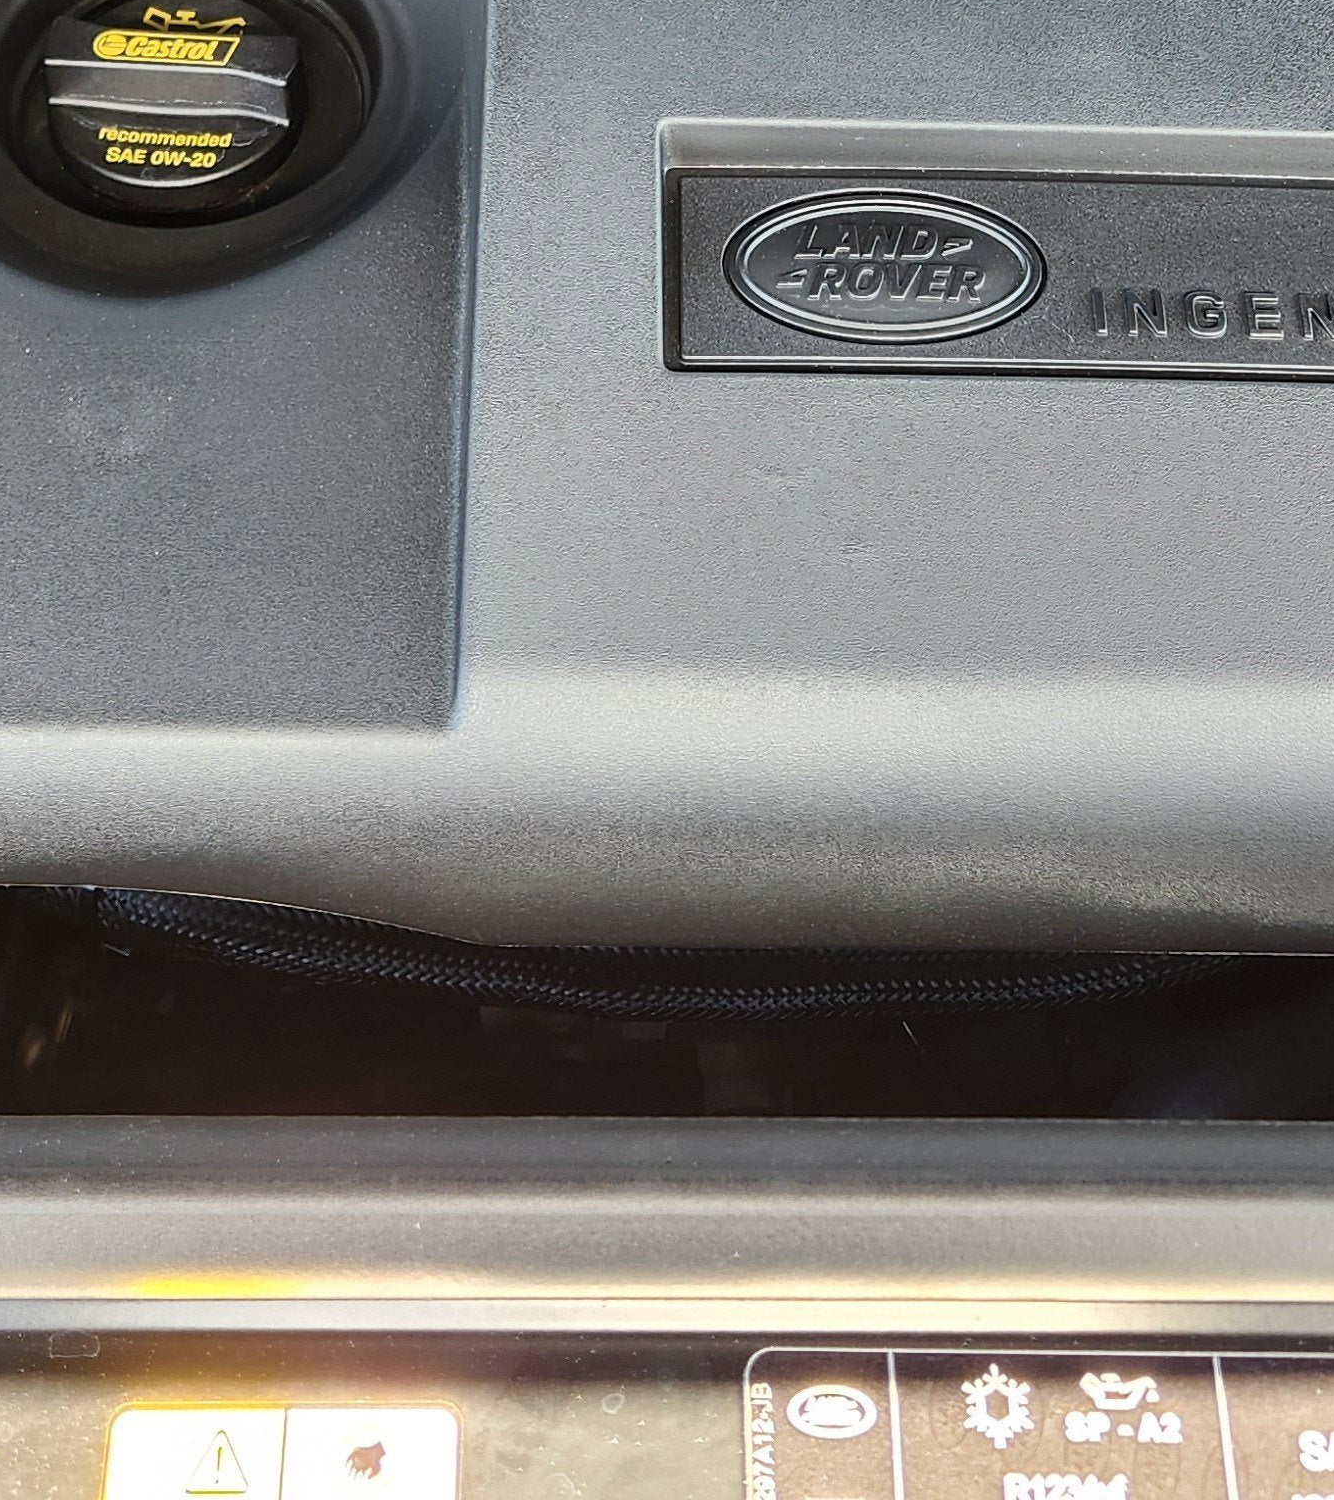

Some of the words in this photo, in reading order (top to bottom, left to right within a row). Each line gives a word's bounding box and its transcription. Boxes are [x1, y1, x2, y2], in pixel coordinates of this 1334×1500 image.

[125, 36, 219, 61] Castrol
[98, 126, 233, 148] recommended
[105, 146, 147, 165] SAE
[150, 148, 217, 168] 0W-20
[794, 222, 939, 260] LAND
[806, 262, 986, 304] ROVER
